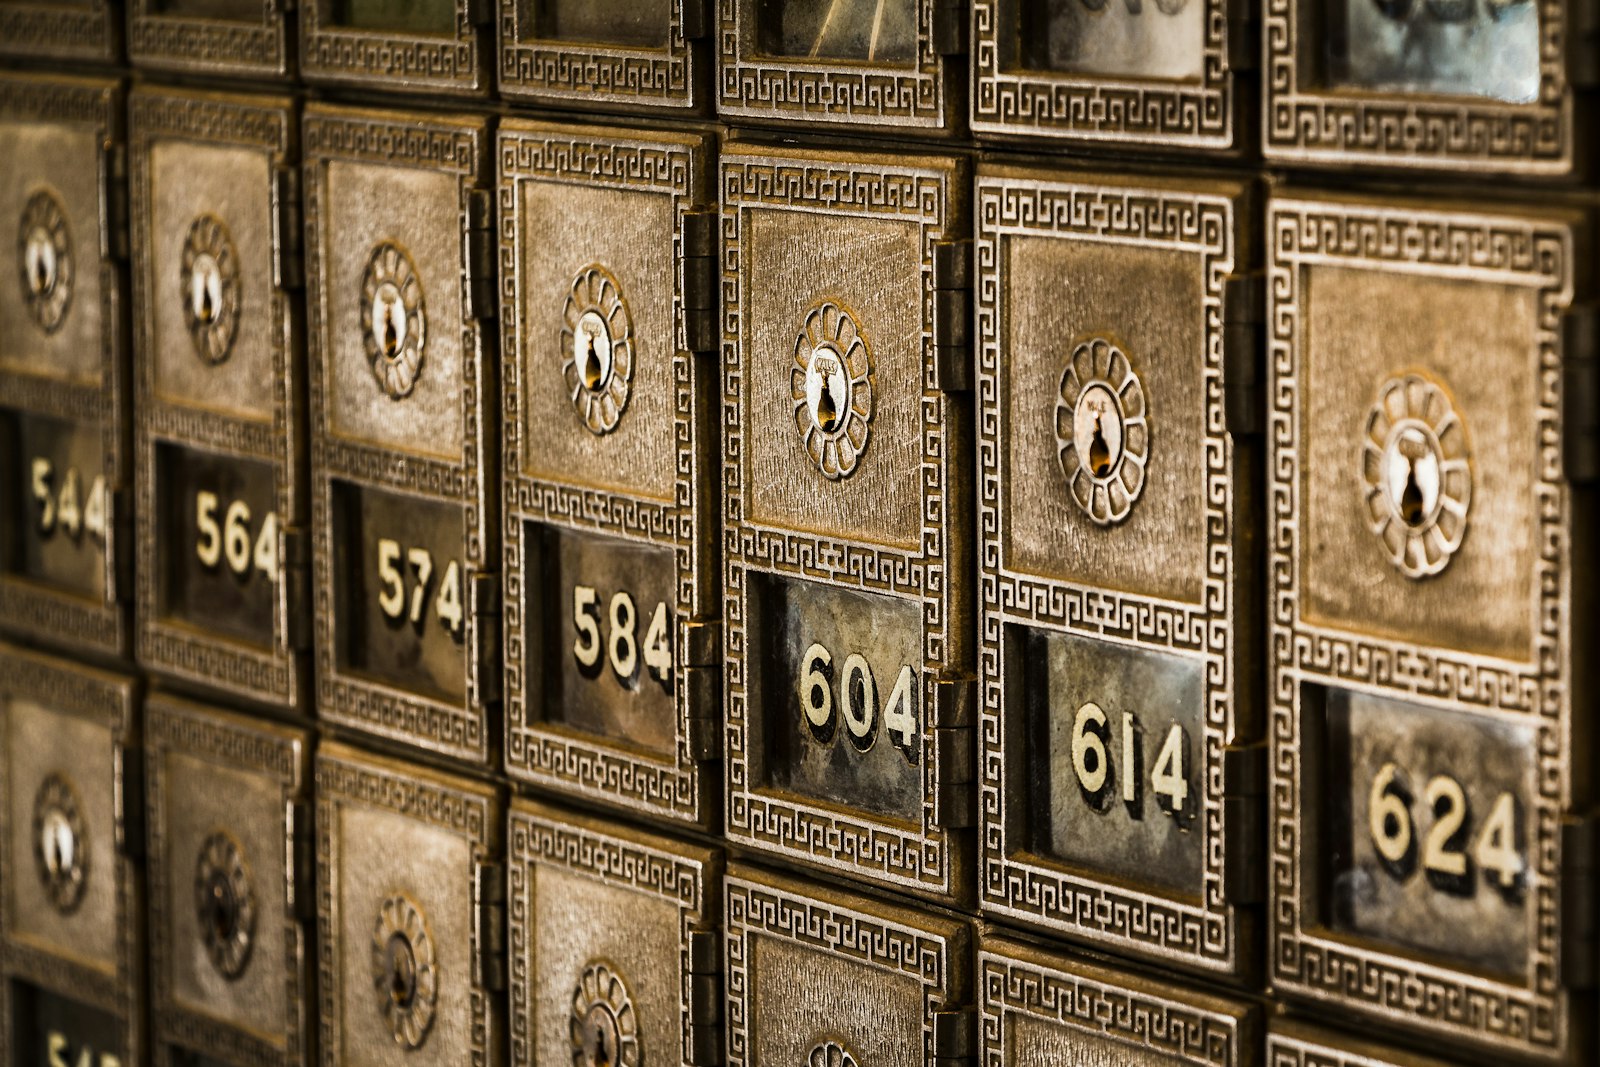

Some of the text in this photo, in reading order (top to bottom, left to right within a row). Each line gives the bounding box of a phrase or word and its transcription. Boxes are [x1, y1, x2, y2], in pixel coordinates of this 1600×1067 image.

[197, 491, 279, 582] 564
[378, 538, 463, 632] 574
[574, 585, 671, 680] 584
[801, 643, 918, 746] 604
[1071, 702, 1188, 811] 614
[1369, 762, 1522, 886] 624
